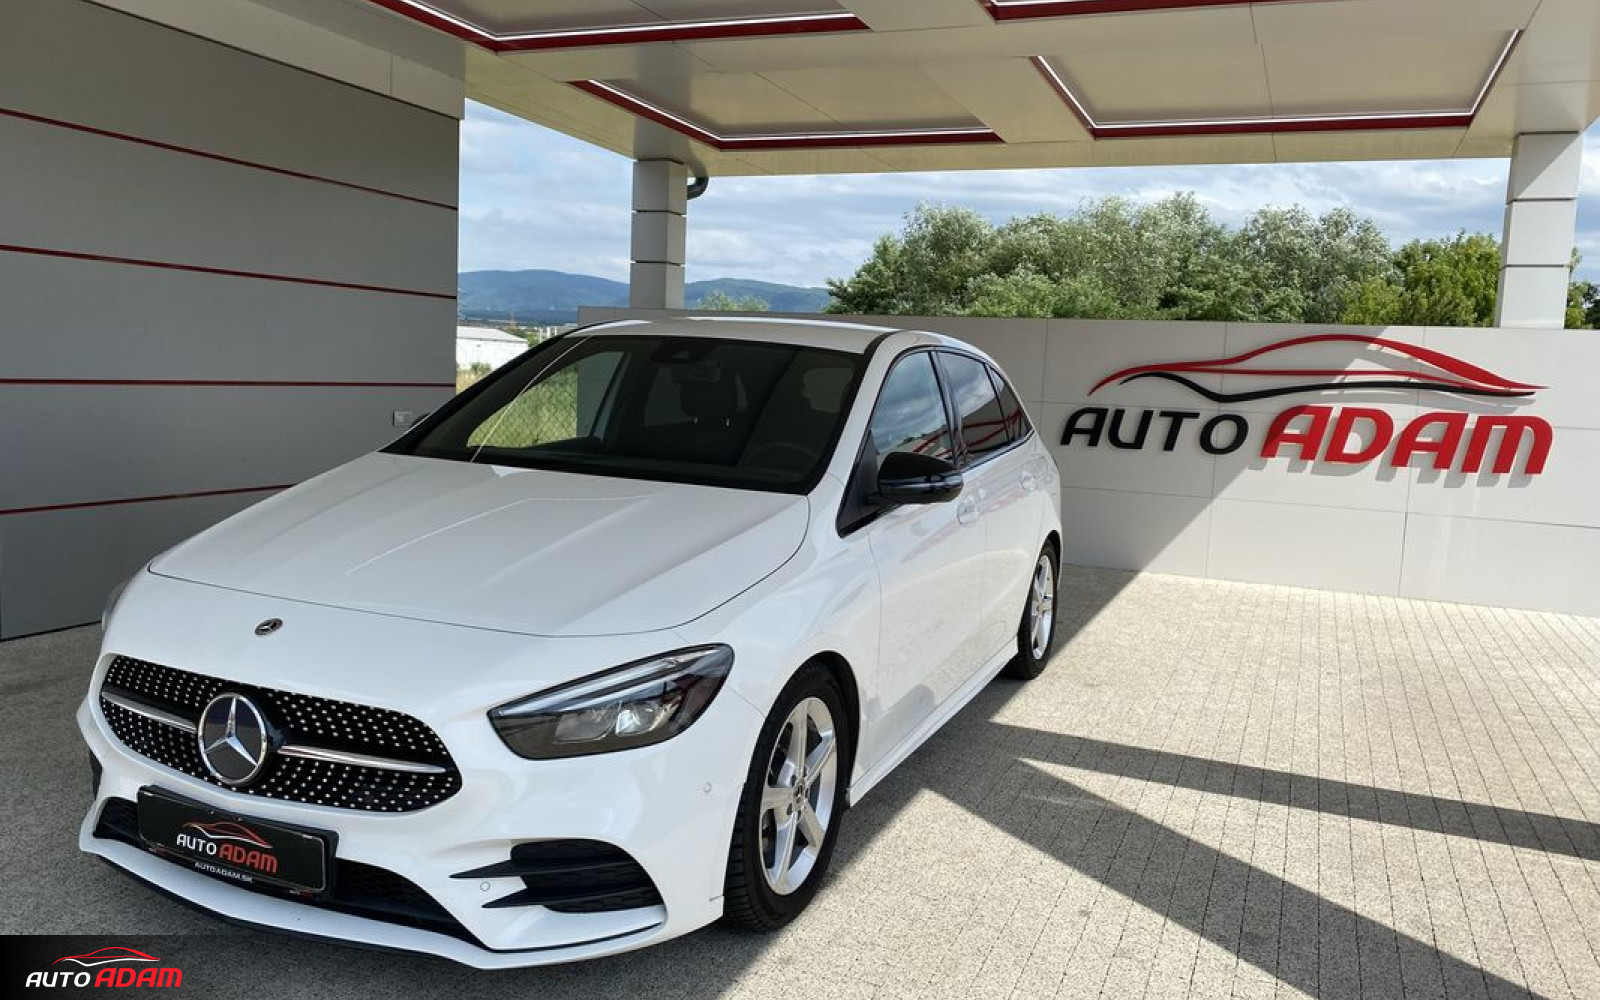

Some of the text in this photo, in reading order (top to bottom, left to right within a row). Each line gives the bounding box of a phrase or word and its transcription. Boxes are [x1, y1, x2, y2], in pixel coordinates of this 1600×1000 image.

[1060, 405, 1553, 475] AUTO ADAM
[176, 833, 278, 874] AUTO ADAM
[194, 861, 253, 883] AUTOADAM.SK
